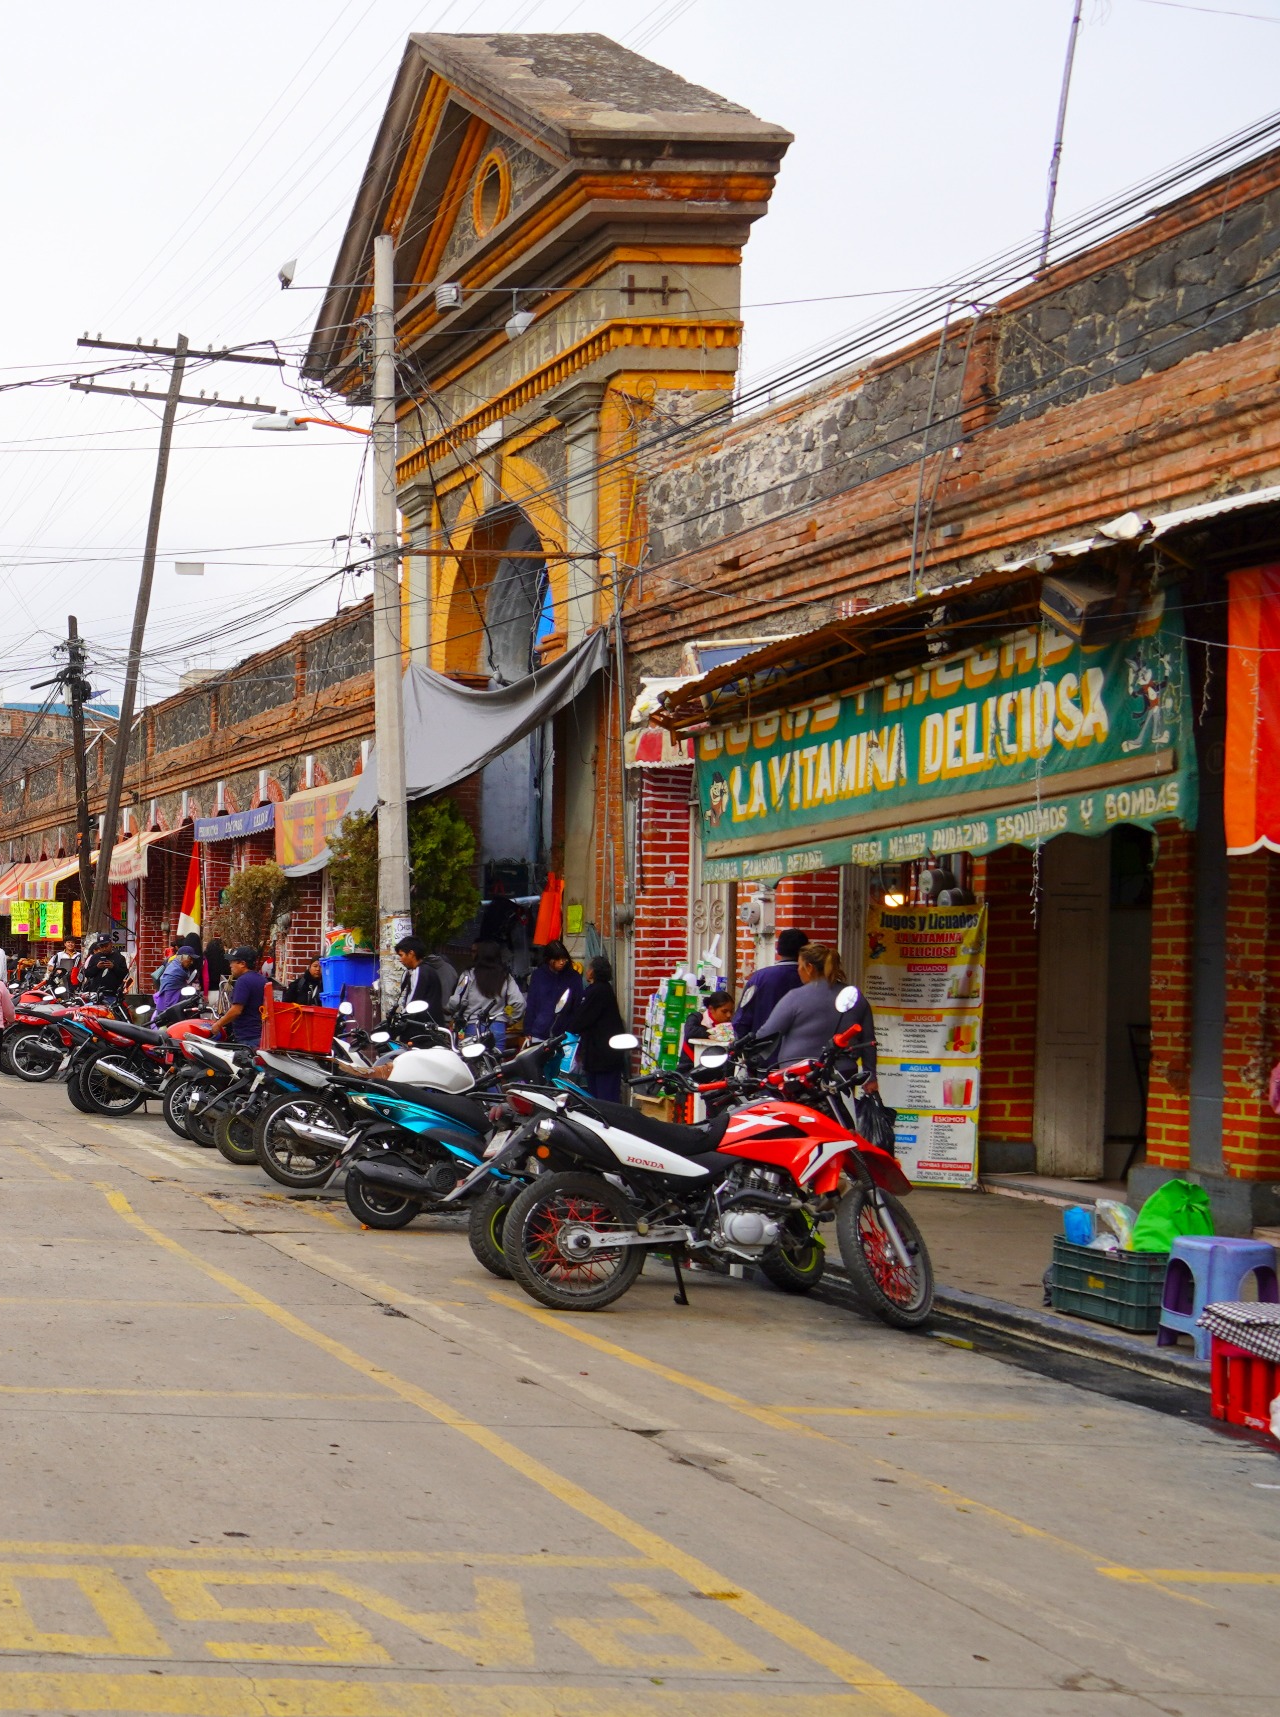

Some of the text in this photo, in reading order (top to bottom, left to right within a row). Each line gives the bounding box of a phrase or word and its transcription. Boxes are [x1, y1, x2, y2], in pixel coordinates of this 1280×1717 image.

[731, 666, 1109, 823] LA VITAMINA DELICIOSA
[851, 840, 883, 864] FRESA
[932, 820, 989, 851] DURAZNO
[1105, 781, 1181, 824] BOMBAS
[880, 911, 979, 931] Jugos y Licuados
[896, 932, 963, 944] LA VITAMINA
[900, 946, 958, 958] DELICIOSA
[627, 1156, 664, 1169] HONDA
